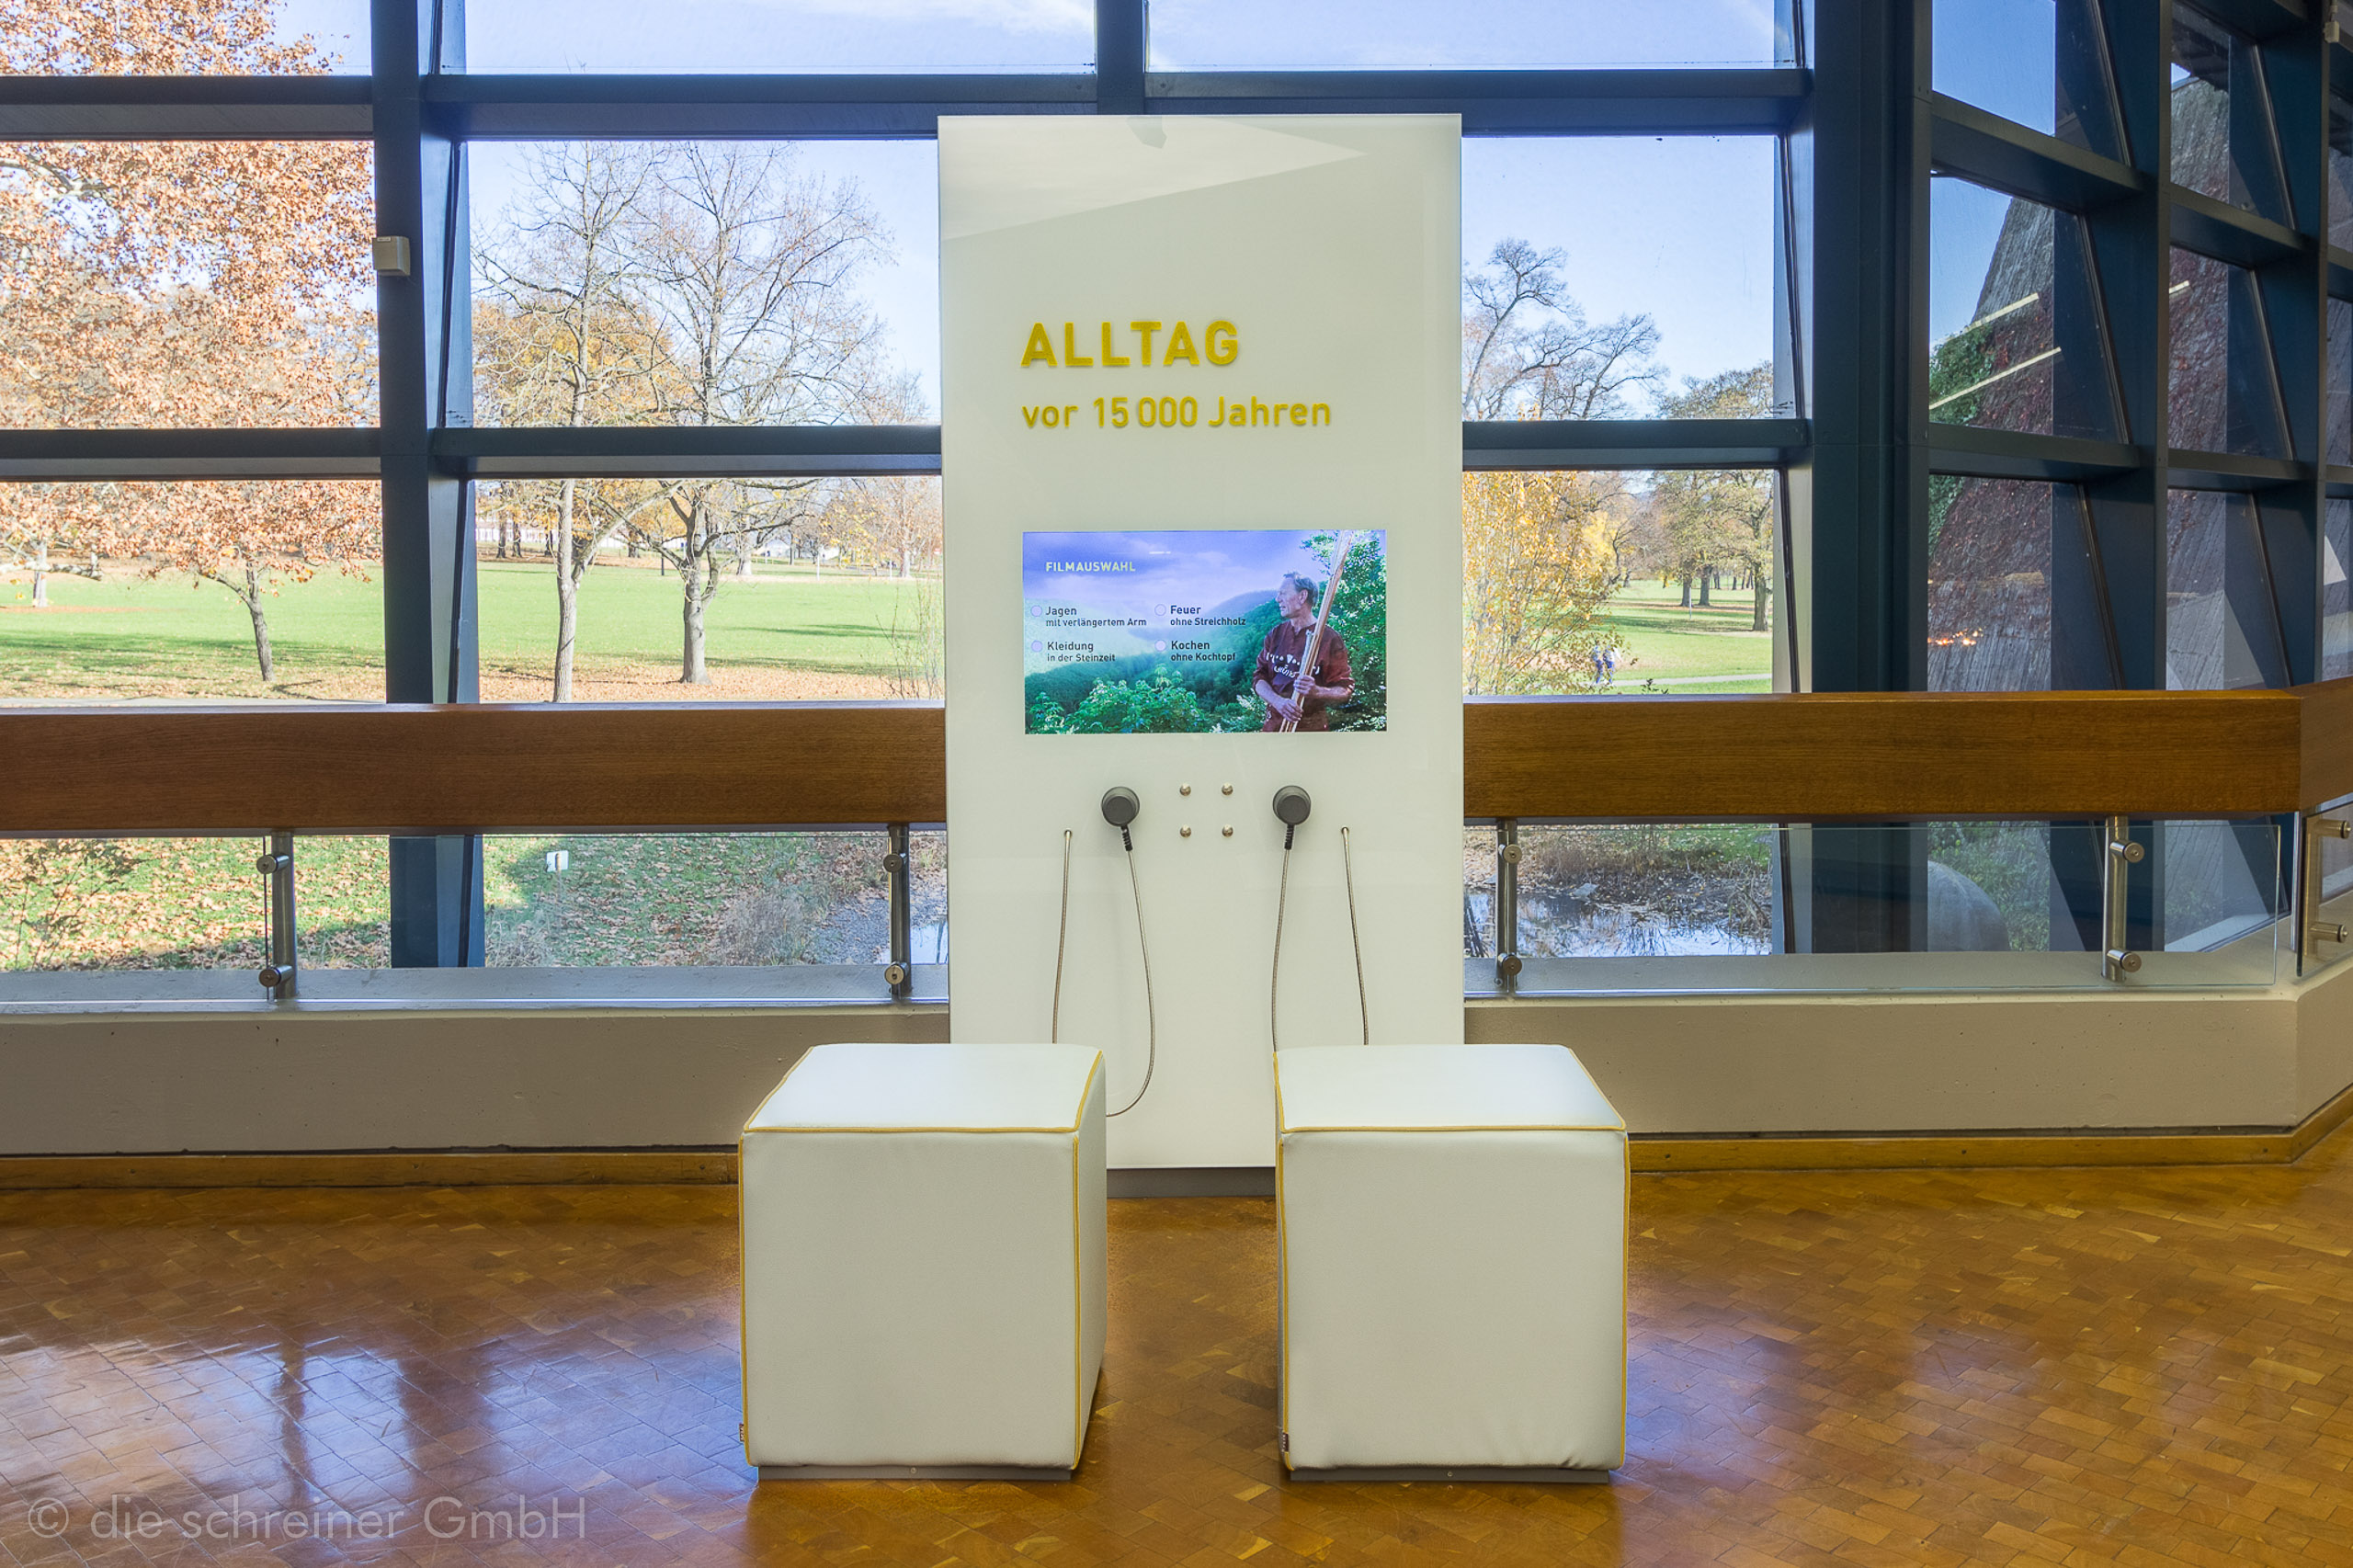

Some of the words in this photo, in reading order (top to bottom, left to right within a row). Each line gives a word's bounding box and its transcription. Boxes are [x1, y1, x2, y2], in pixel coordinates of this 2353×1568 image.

[1020, 320, 1239, 368] ALLTAG
[1022, 405, 1079, 427] vor
[1208, 396, 1331, 426] Jahren
[1046, 561, 1136, 572] FILMAUSWAHL
[1046, 606, 1077, 617] Jagen
[1170, 605, 1201, 615] Feuer
[1046, 618, 1062, 627] mit
[1063, 617, 1125, 628] verlängertem
[1127, 618, 1147, 626] Arm
[1170, 617, 1193, 626] ohne
[1194, 617, 1246, 626] Streichholz
[1047, 642, 1094, 653] Kleidung
[1171, 641, 1211, 651] Kochen
[1047, 653, 1056, 662] in
[1057, 653, 1074, 663] der
[1075, 653, 1116, 663] Steinzeit
[1170, 653, 1193, 662] ohne
[1195, 652, 1236, 663] Kochtopf
